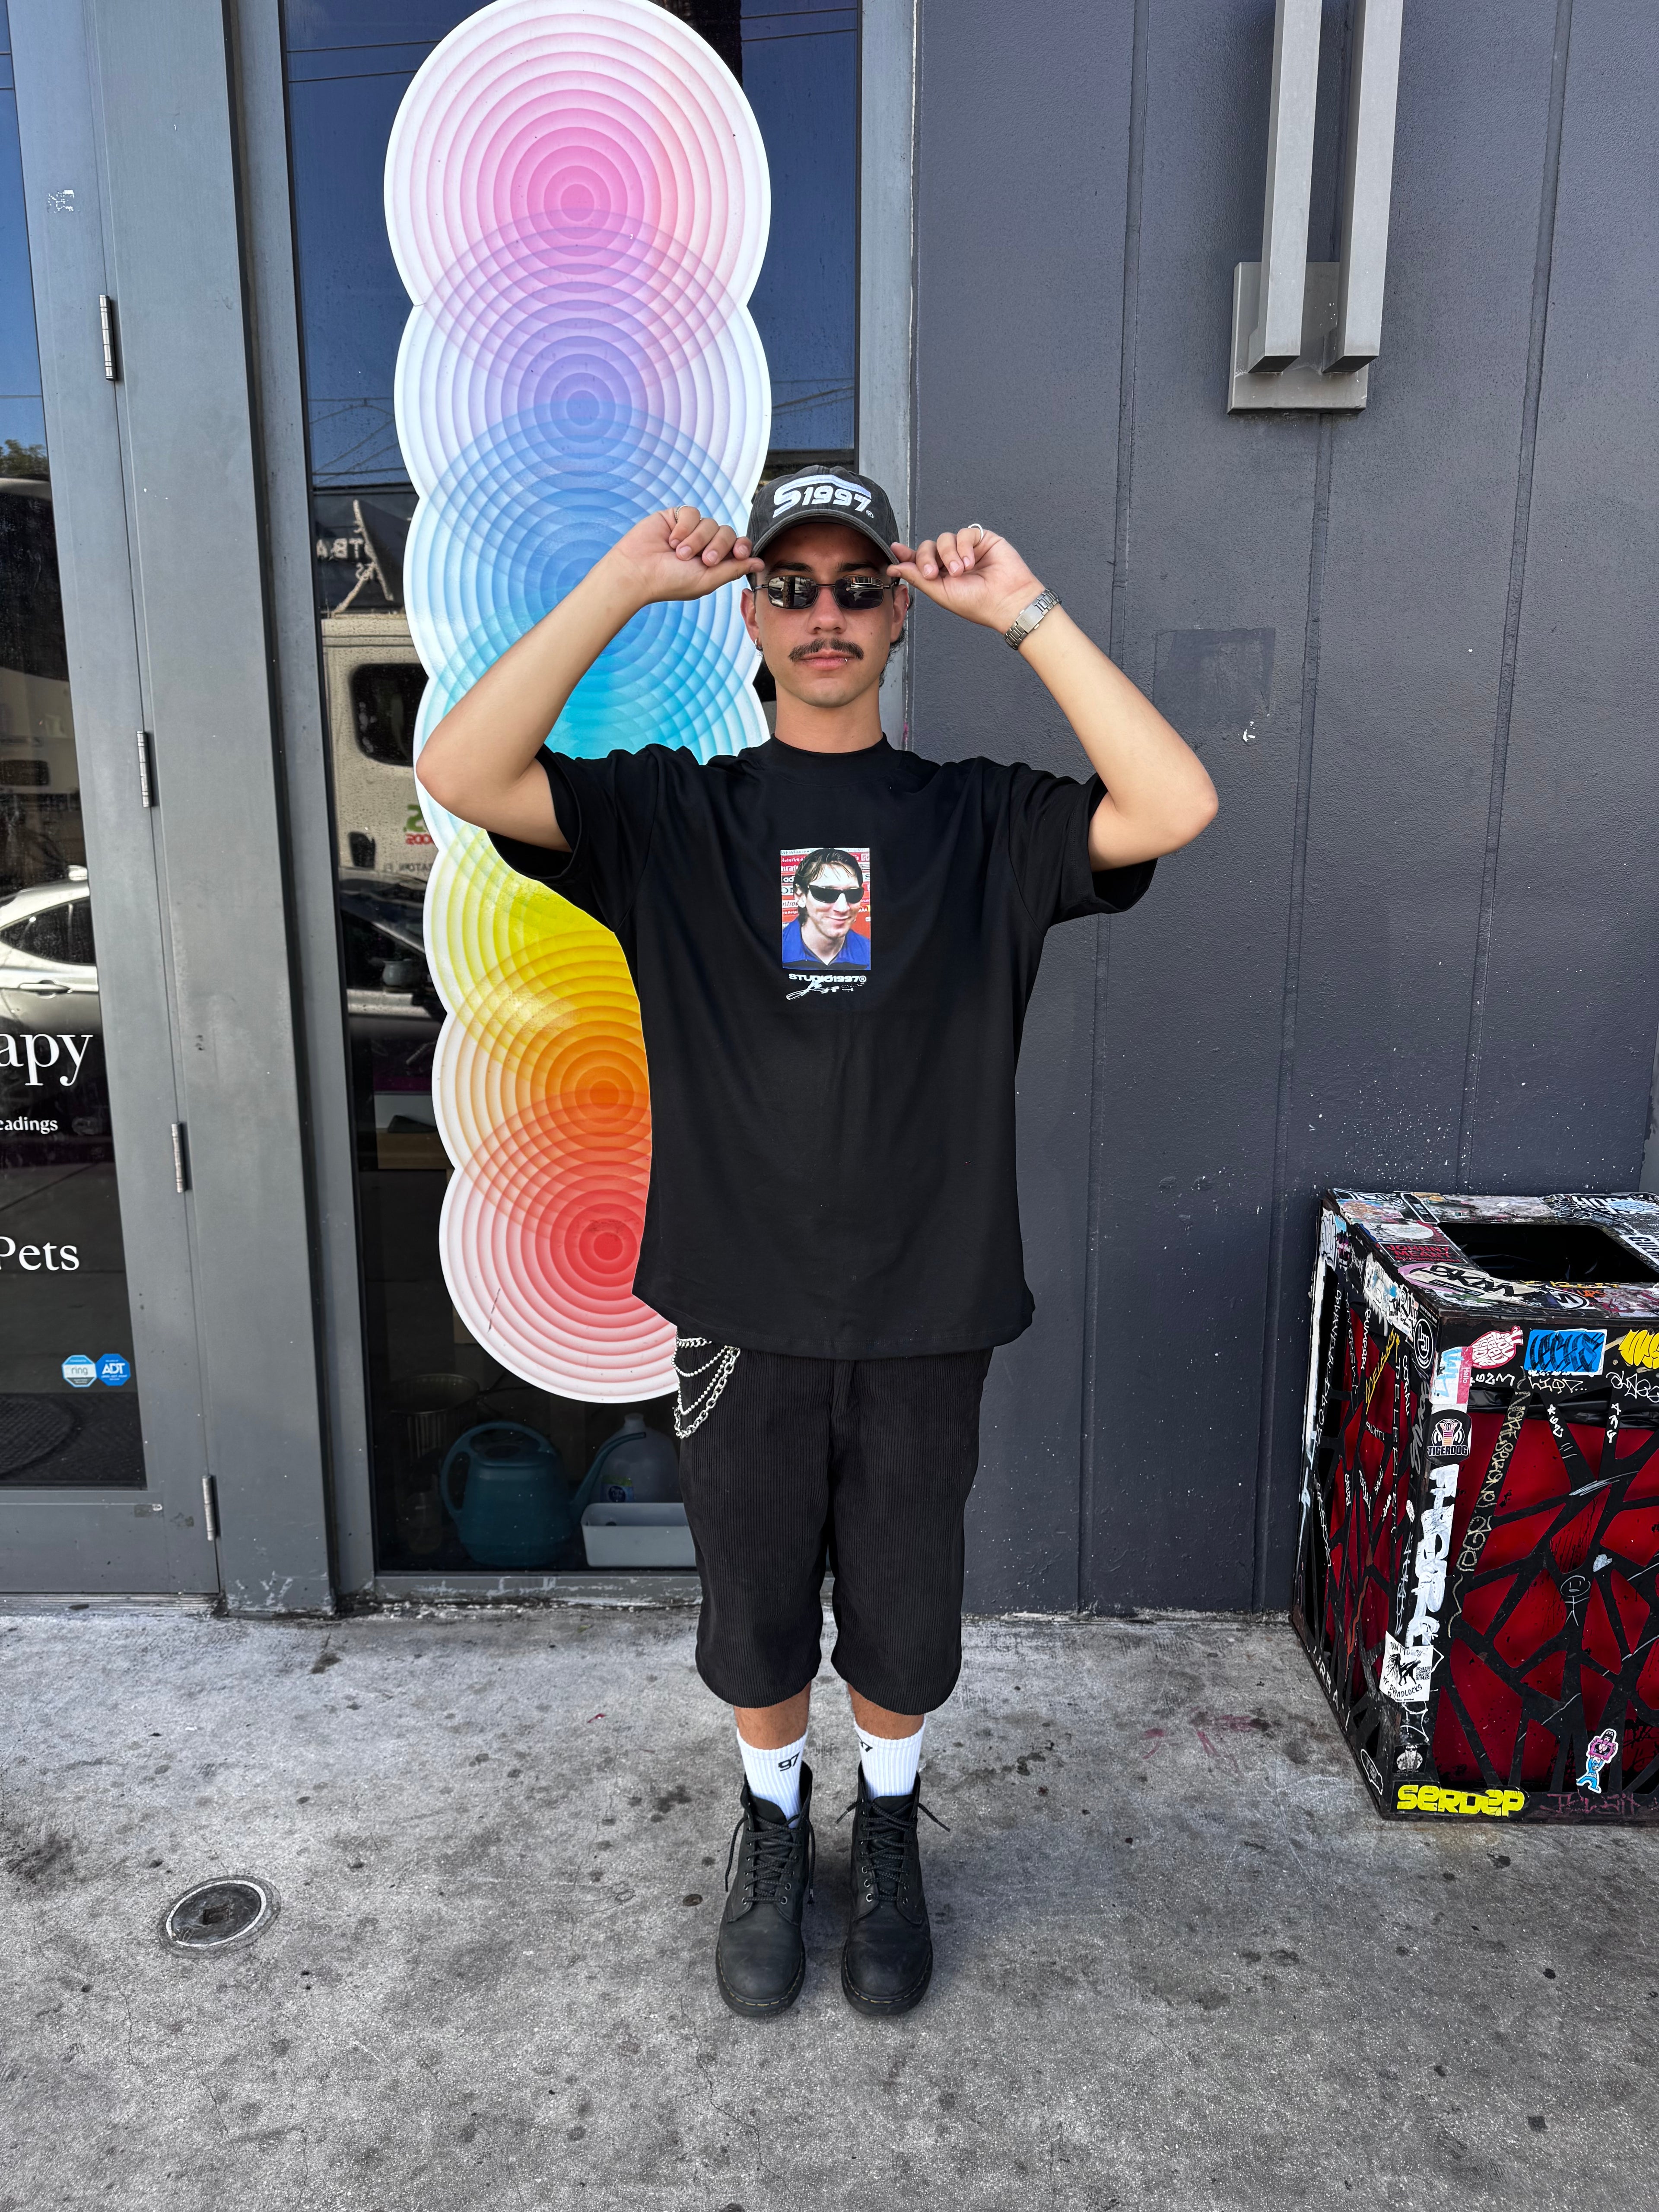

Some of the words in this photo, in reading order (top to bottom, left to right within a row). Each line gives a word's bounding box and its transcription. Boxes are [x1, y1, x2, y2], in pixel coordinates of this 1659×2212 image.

[0, 1033, 93, 1086] apy
[0, 1236, 79, 1271] Pets
[71, 1367, 89, 1376] ring
[102, 1363, 126, 1375] ADT
[1427, 1445, 1468, 1457] TIGERDOG
[778, 1751, 800, 1772] 97
